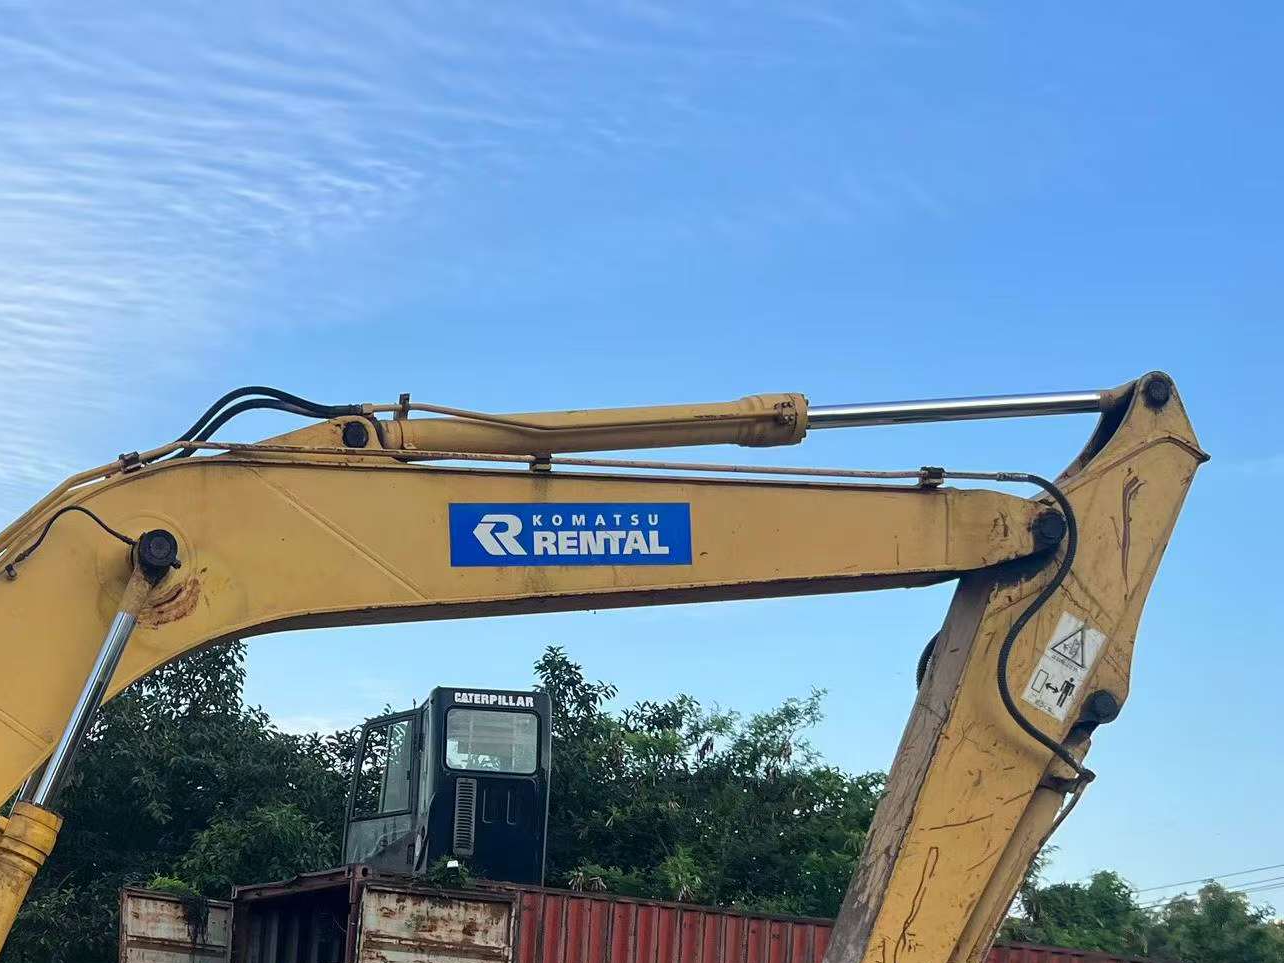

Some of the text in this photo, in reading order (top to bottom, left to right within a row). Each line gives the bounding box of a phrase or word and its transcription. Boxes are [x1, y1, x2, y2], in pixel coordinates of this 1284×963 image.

[532, 514, 659, 526] KOMATSU
[533, 530, 670, 556] RENTAL
[454, 692, 534, 707] CATERPILLAR
